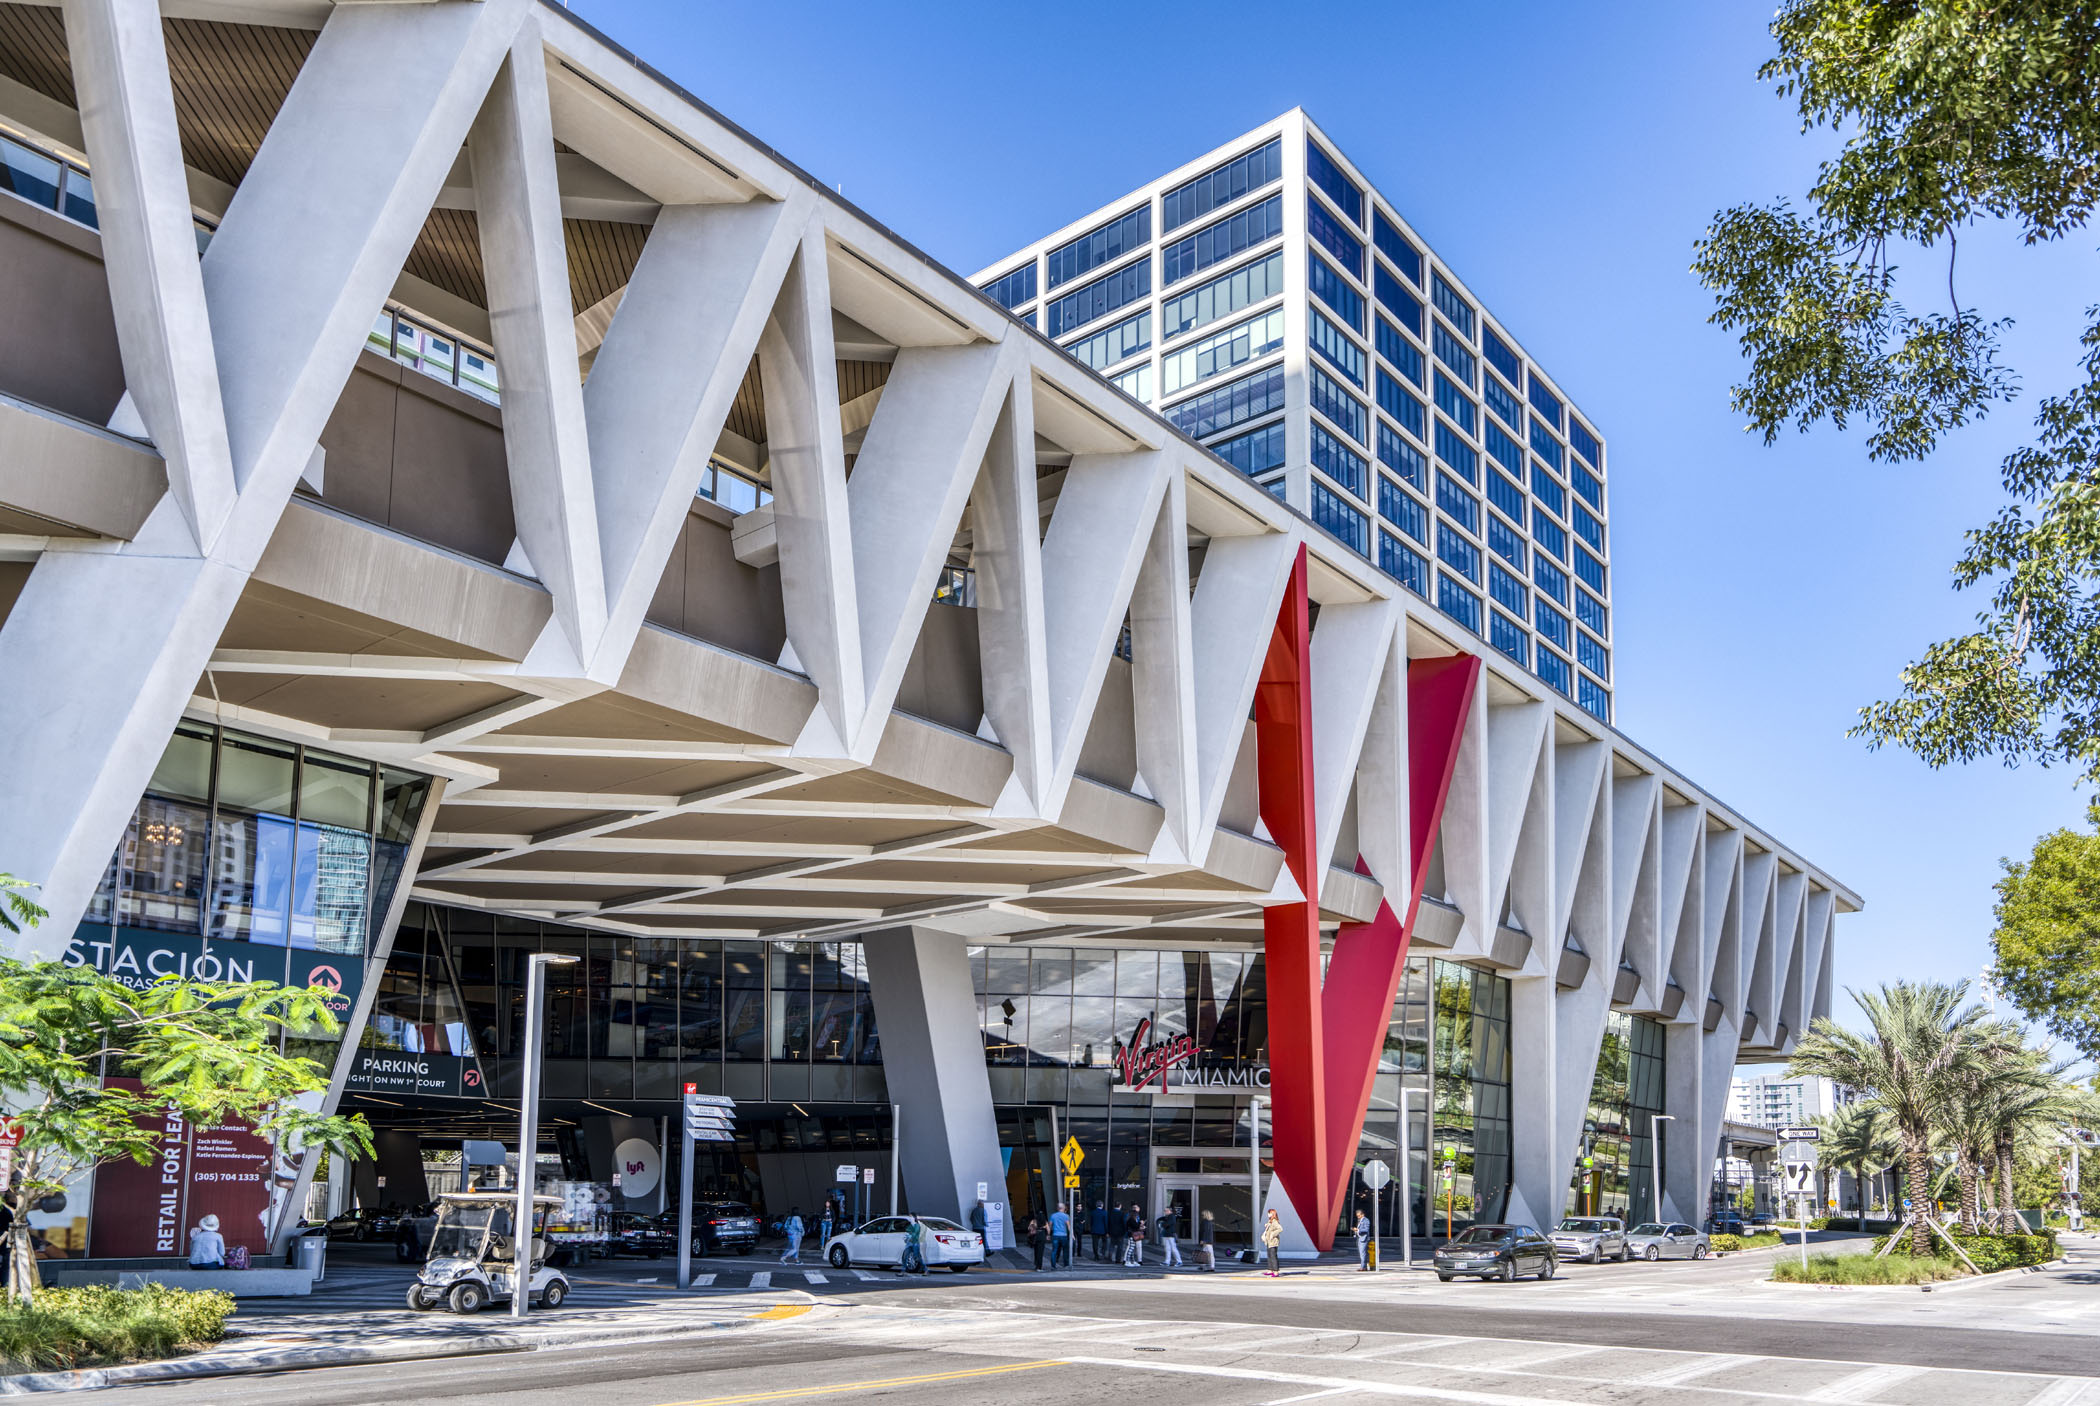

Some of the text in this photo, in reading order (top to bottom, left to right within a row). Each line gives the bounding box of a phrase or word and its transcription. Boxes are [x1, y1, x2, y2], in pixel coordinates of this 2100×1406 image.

[63, 938, 254, 985] STACIÓN
[363, 1058, 429, 1075] PARKING
[1116, 1020, 1201, 1095] Virgin
[348, 1074, 371, 1082] IGHT
[374, 1076, 388, 1084] ON
[417, 1079, 446, 1088] COURT
[1181, 1066, 1271, 1088] MIAMIC
[156, 1100, 184, 1251] RETAIL FOR LEAS
[194, 1172, 260, 1182] (305) 704 1333
[626, 1161, 645, 1175] lyft
